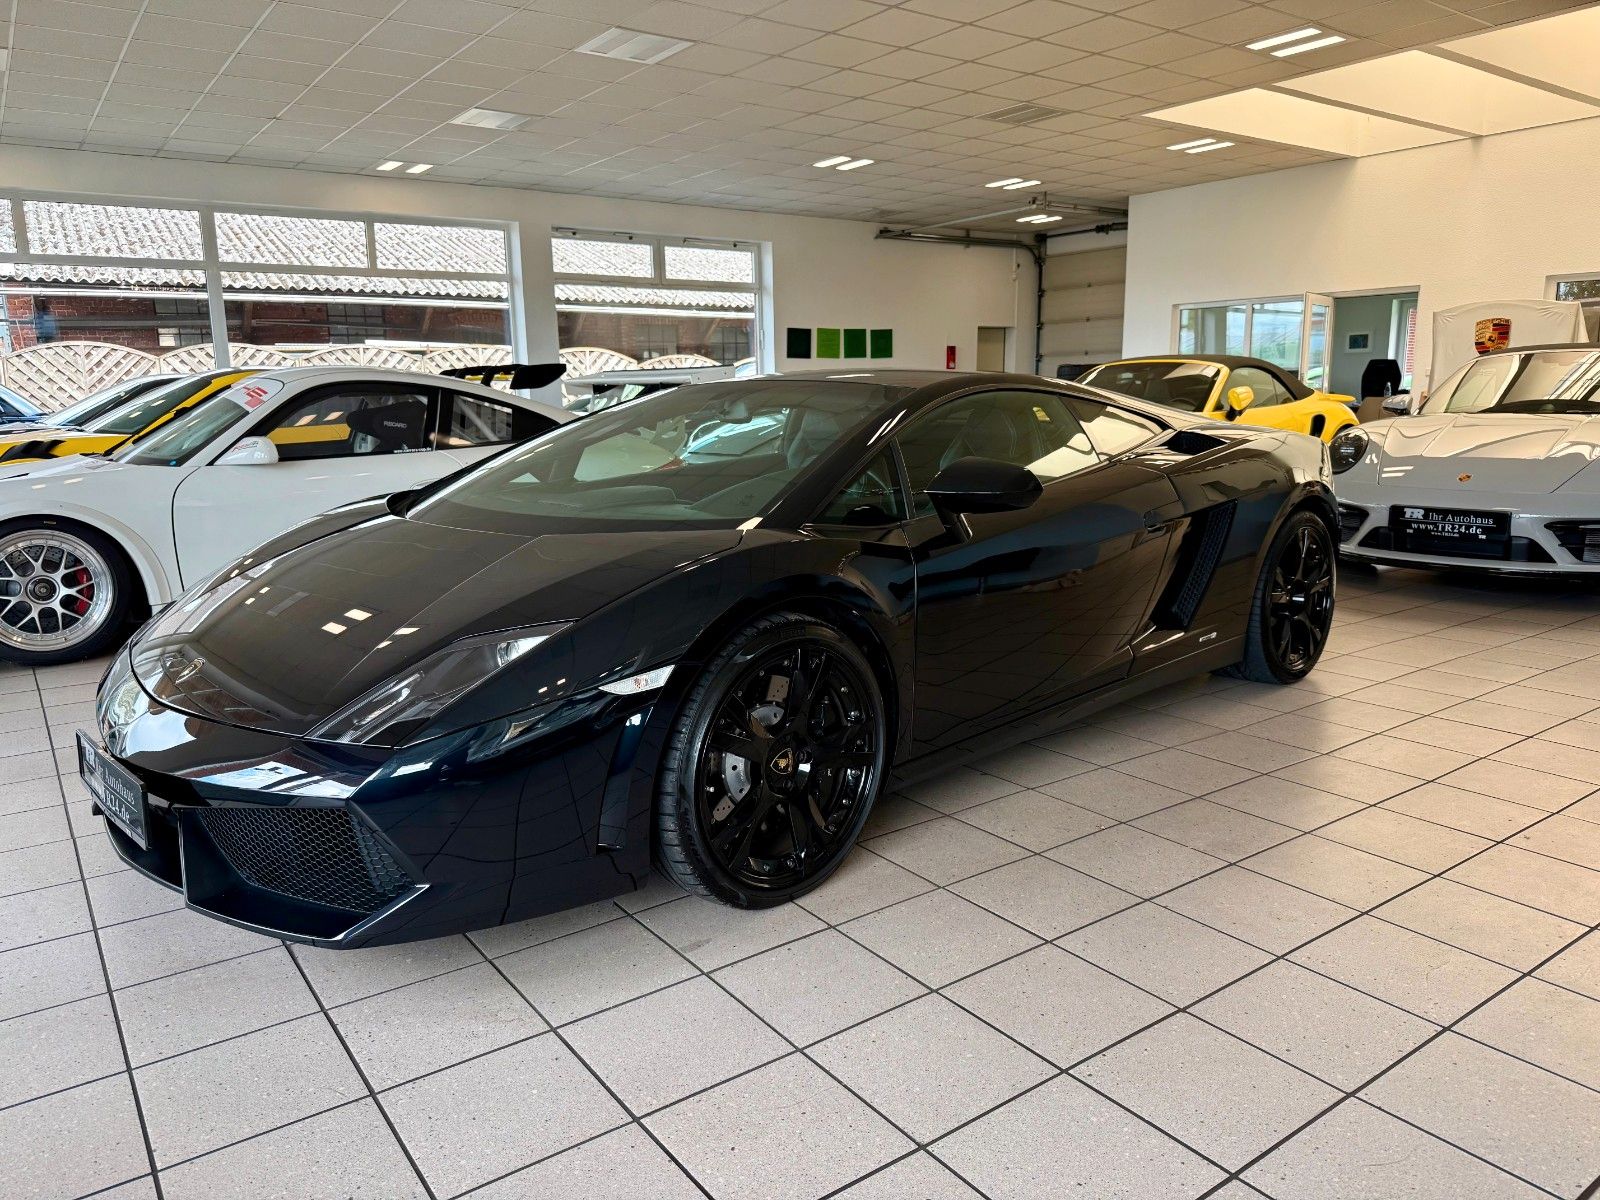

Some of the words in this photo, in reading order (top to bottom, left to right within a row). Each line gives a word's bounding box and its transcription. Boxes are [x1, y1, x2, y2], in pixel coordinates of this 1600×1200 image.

[1429, 512, 1442, 520] Ihr
[1446, 514, 1494, 524] Autohaus
[1411, 522, 1482, 534] www.TR24.de
